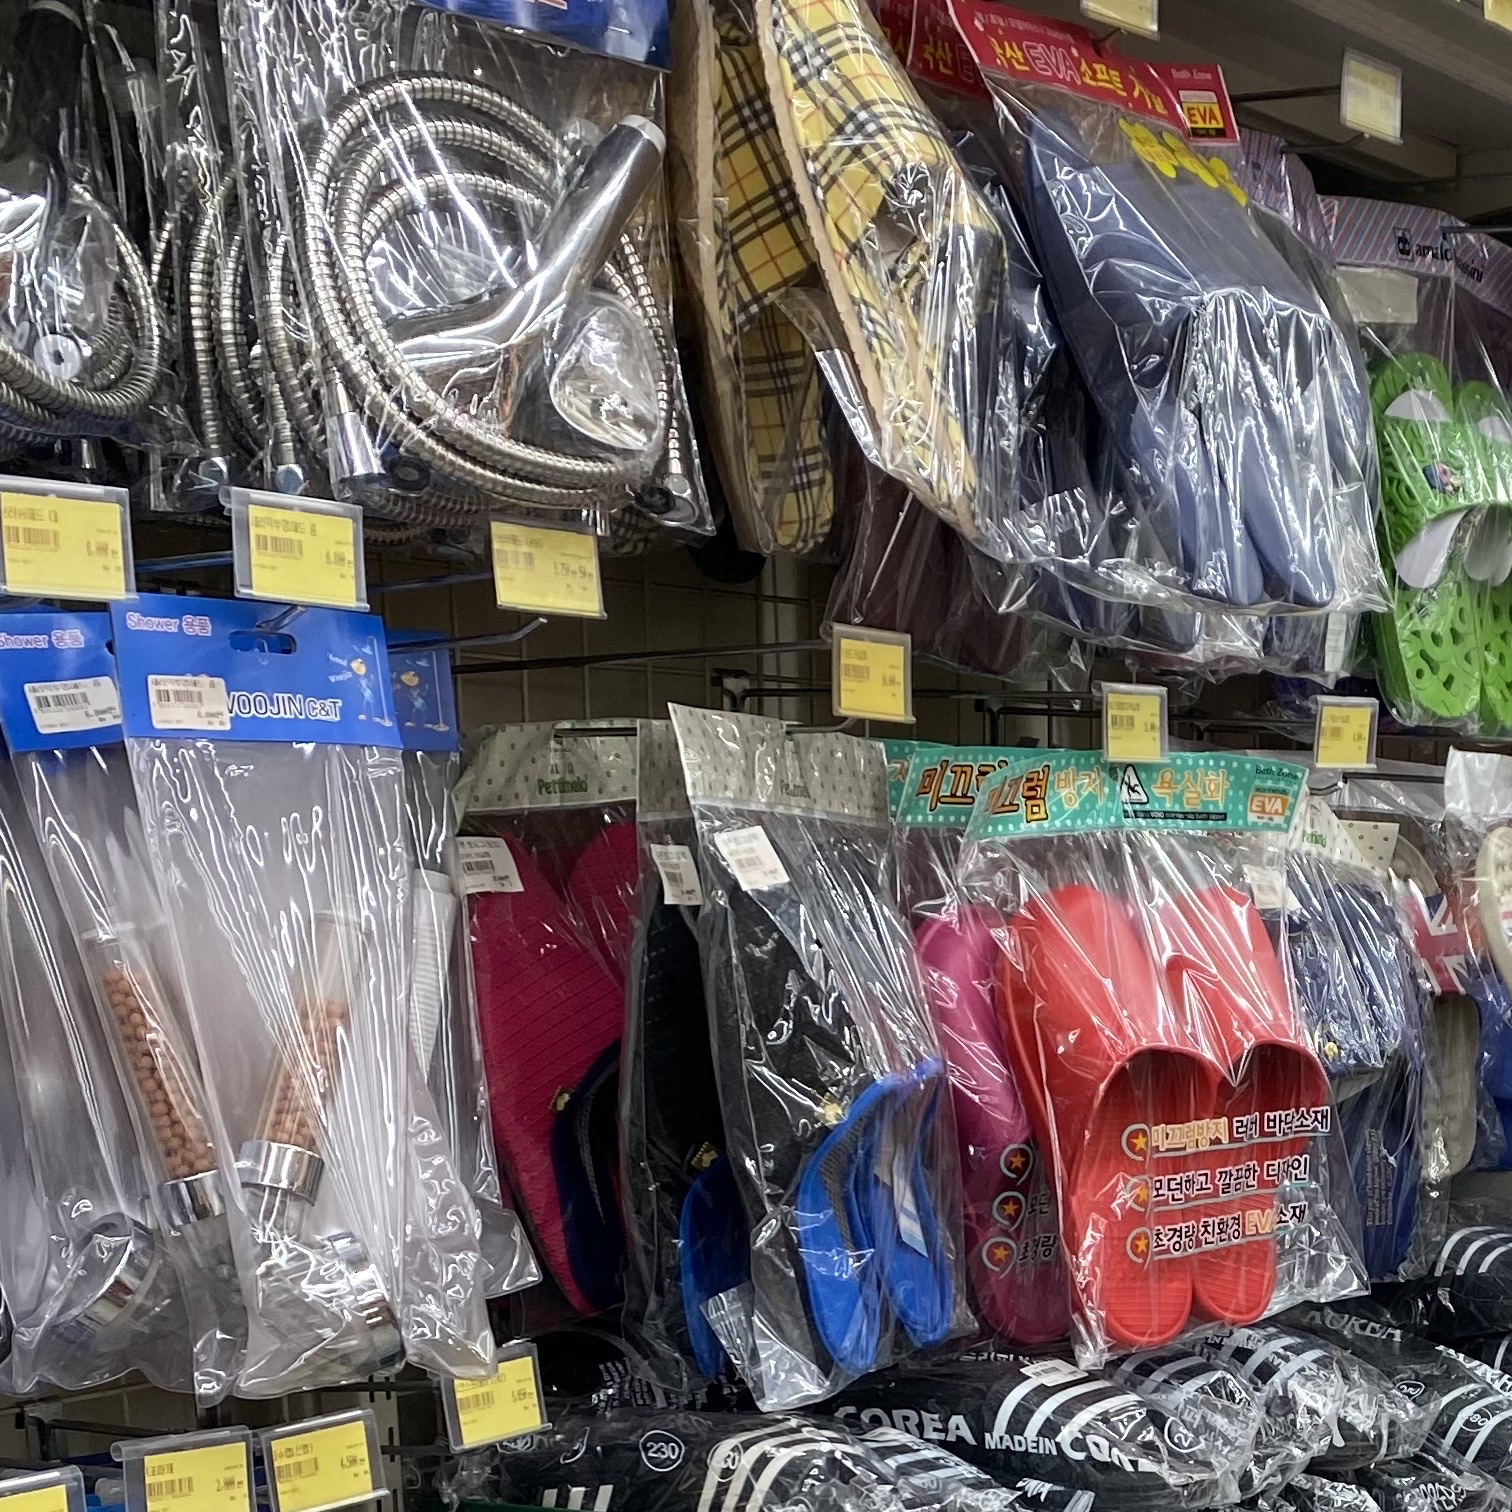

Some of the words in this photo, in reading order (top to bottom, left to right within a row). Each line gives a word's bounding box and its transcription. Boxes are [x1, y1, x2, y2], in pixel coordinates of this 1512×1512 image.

[1023, 41, 1081, 86] EVA
[1080, 57, 1128, 98] 소프트
[1186, 105, 1220, 126] EVA
[126, 611, 179, 632] Shower
[181, 614, 212, 637] 용품
[0, 632, 49, 649] Shower
[51, 629, 84, 650] 용품
[306, 699, 343, 720] C&T
[1055, 766, 1107, 809] 방지
[1151, 767, 1229, 809] 욕실화
[1250, 795, 1284, 815] EVA
[1151, 1117, 1228, 1151] 미끄럼방지
[1264, 1105, 1331, 1136] 바닥소재
[1151, 1172, 1212, 1202] 모던하고
[1216, 1162, 1260, 1195] 깔끔한
[1264, 1153, 1311, 1185] 디자인
[1151, 1223, 1198, 1253] 초경량
[1199, 1215, 1242, 1246] 친환경
[645, 1440, 680, 1461] 230
